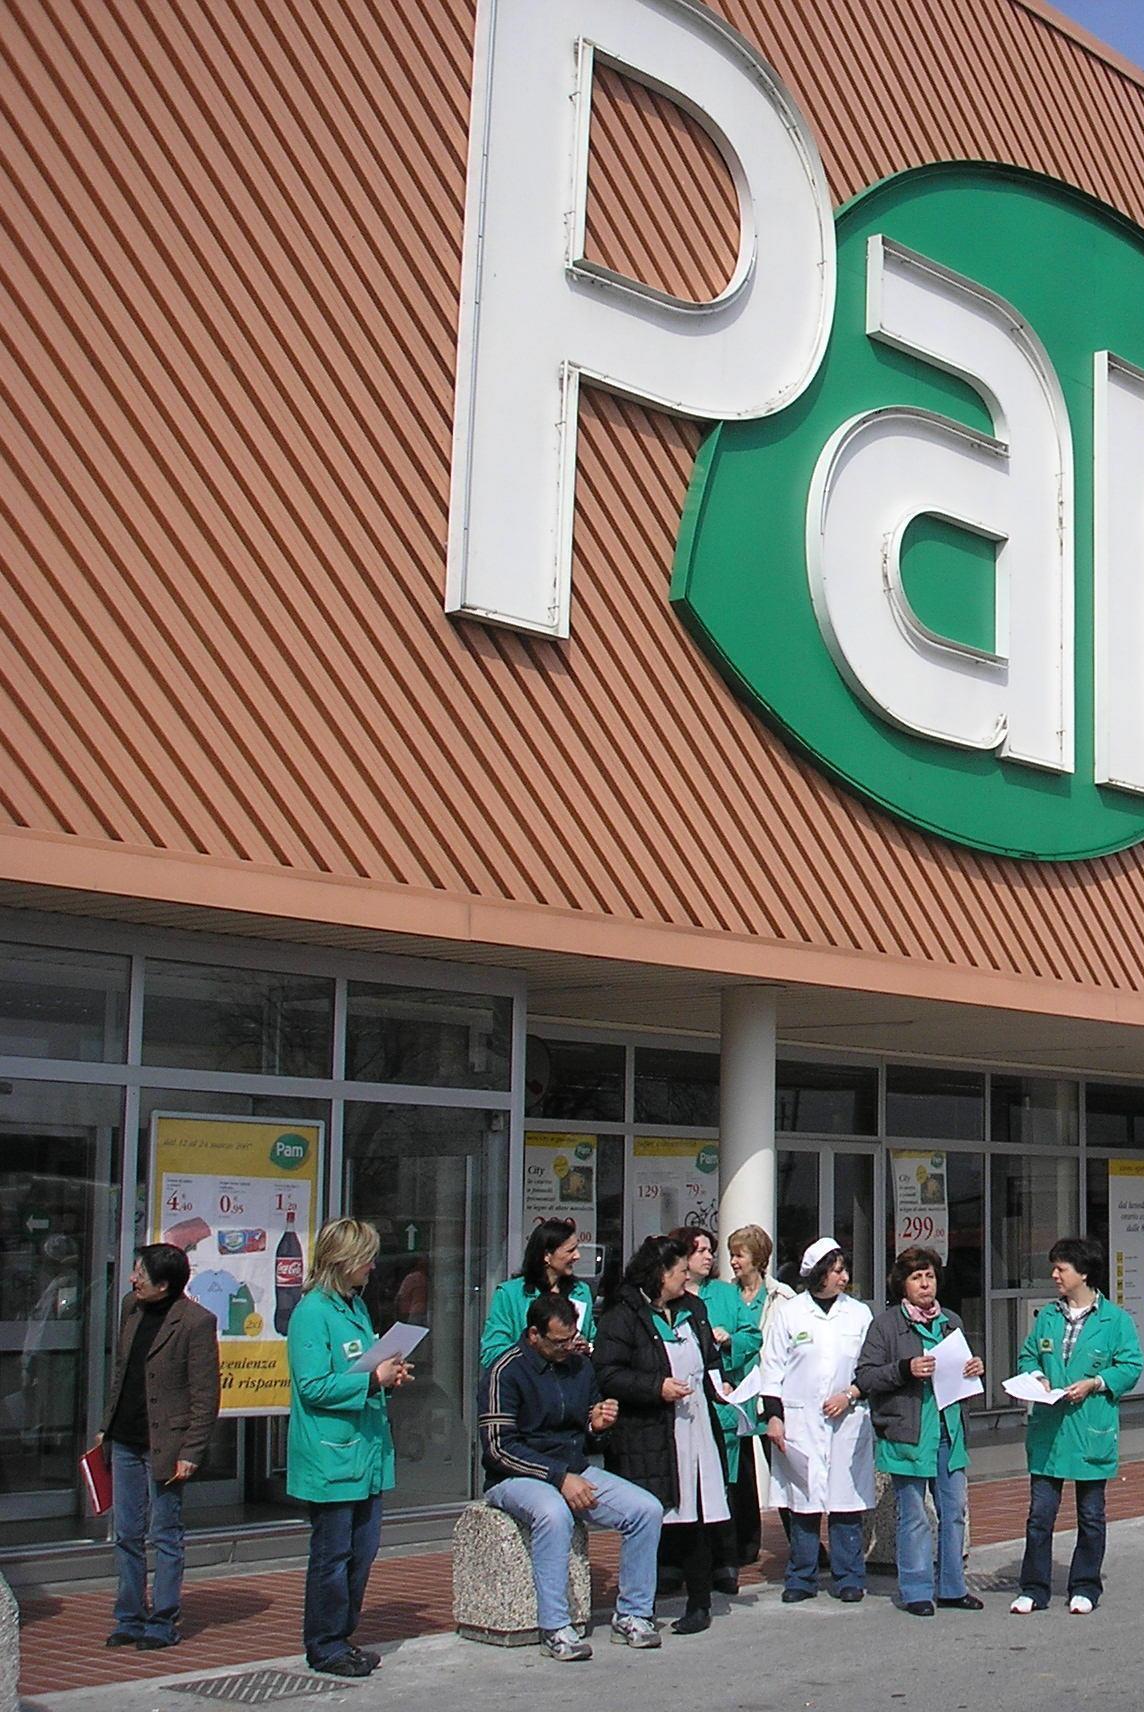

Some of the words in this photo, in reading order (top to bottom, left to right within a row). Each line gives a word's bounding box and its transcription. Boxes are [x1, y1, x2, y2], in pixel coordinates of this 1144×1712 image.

[276, 1142, 304, 1157] Pam
[527, 1165, 545, 1177] City
[220, 1357, 277, 1370] venienza
[238, 1376, 291, 1393] risparm
